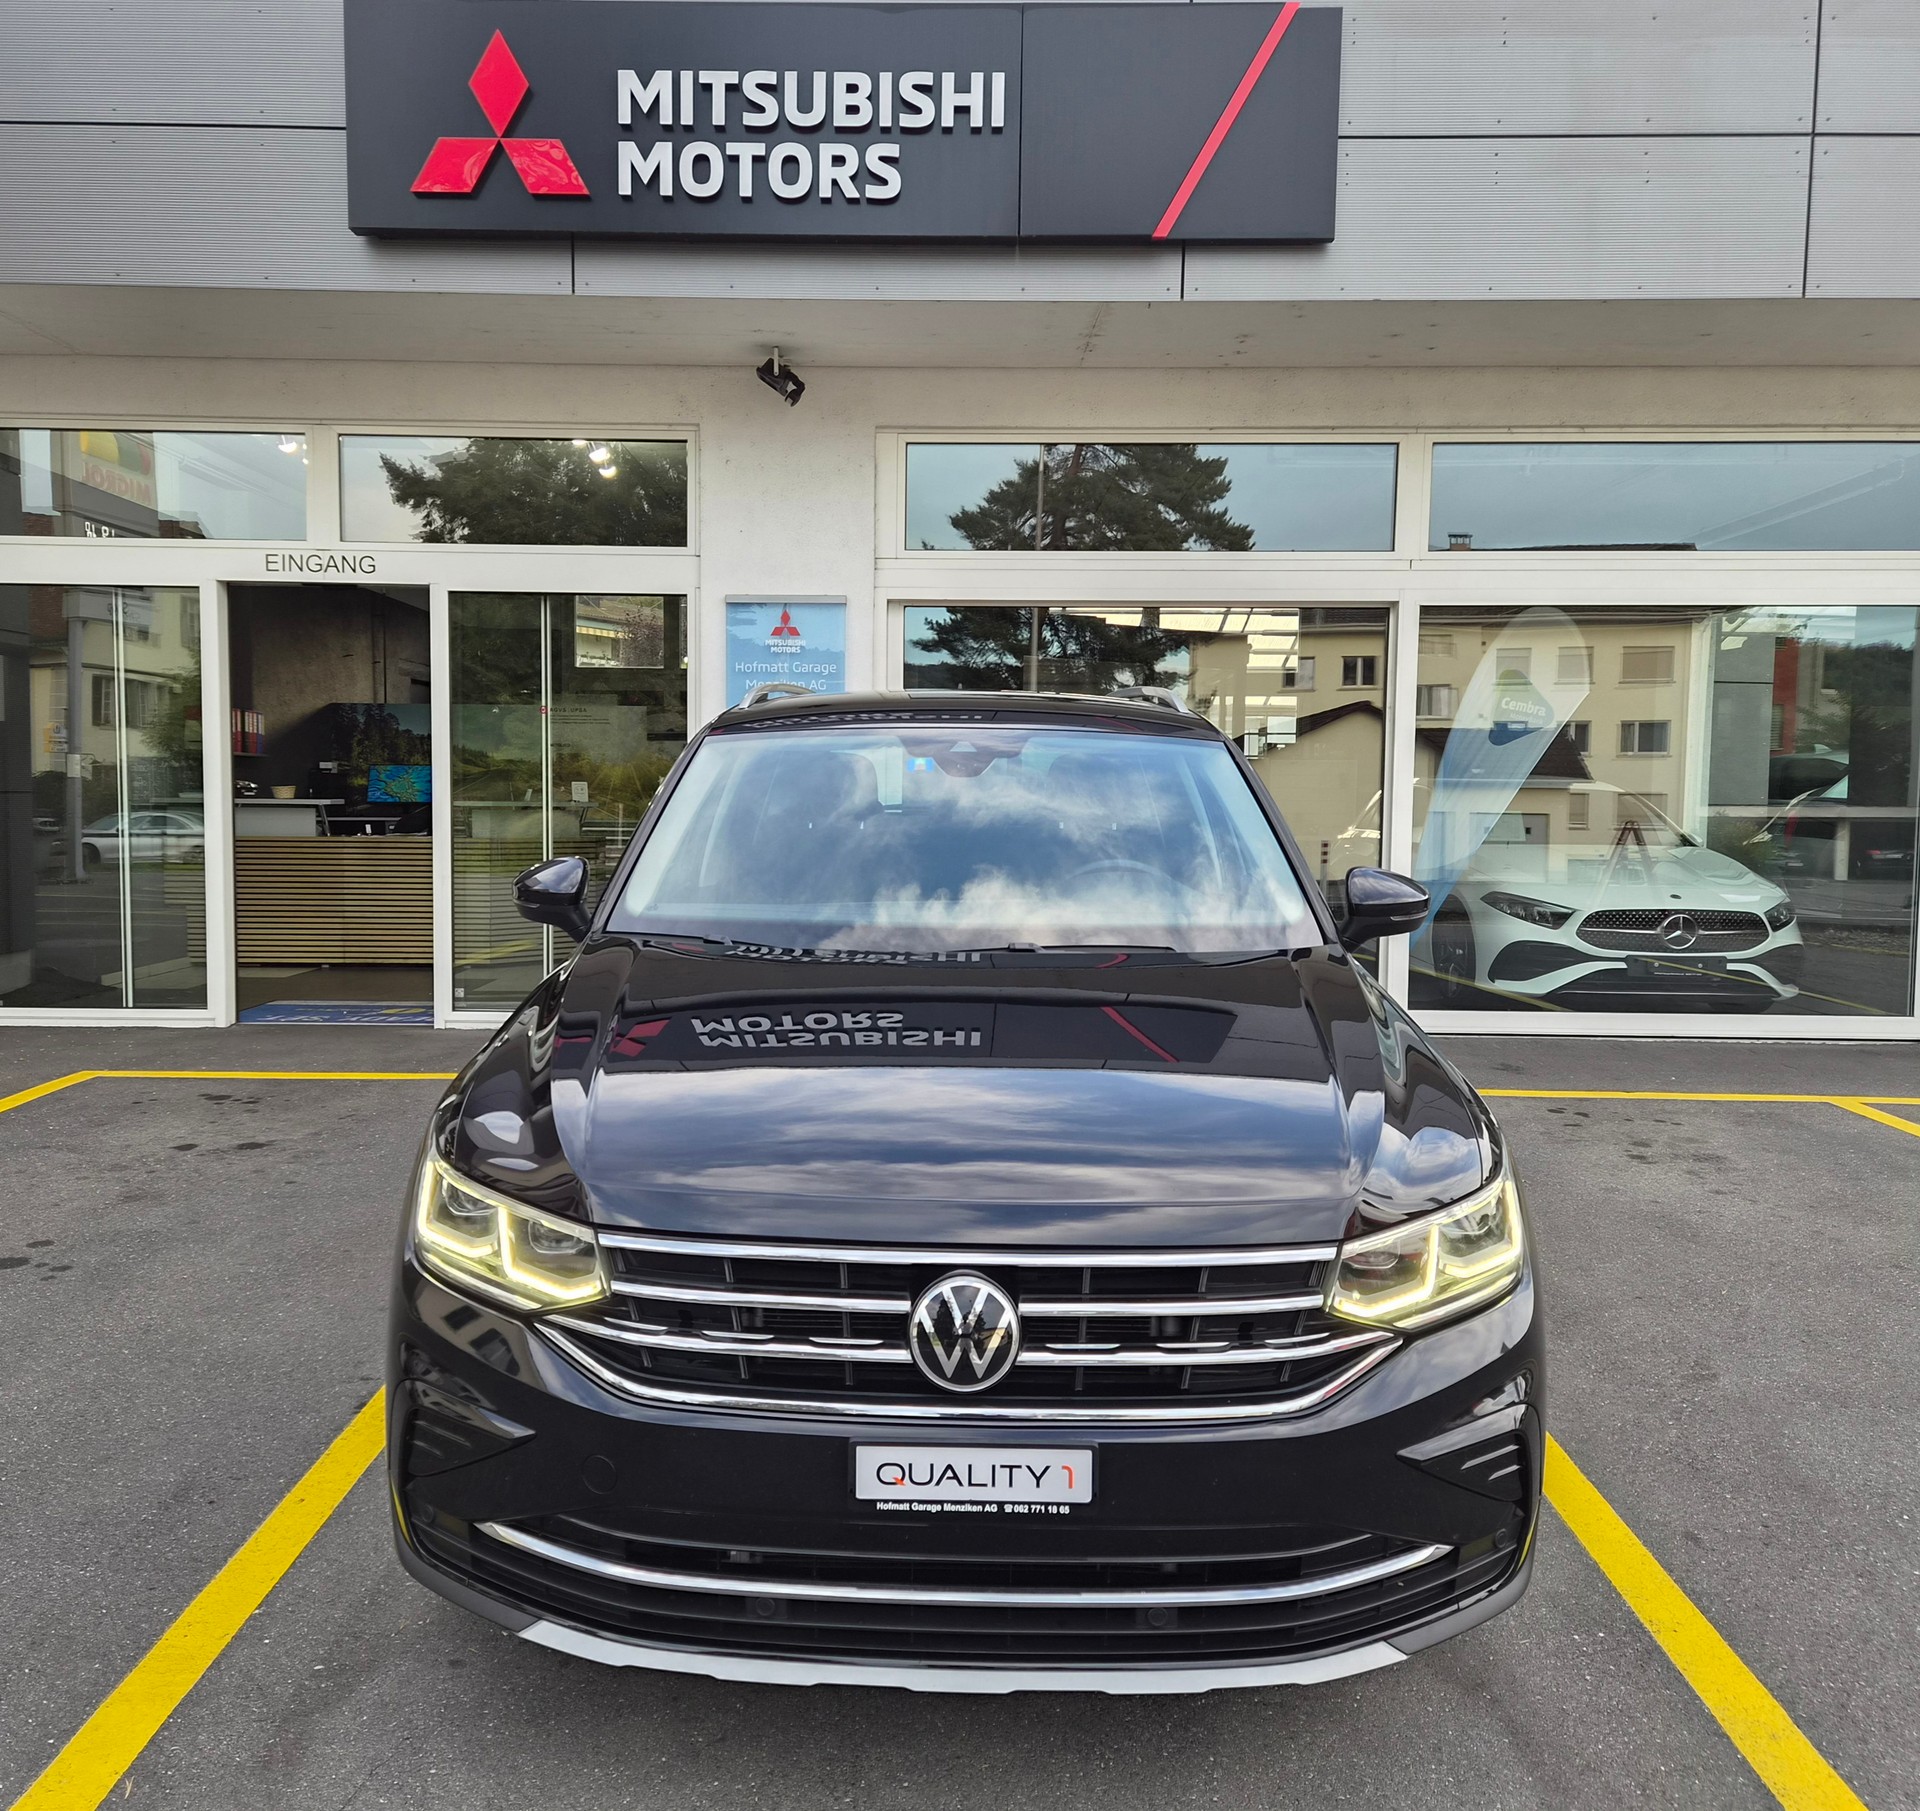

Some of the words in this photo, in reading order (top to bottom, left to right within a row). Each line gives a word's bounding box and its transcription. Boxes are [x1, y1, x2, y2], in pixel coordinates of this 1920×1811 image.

[617, 68, 1006, 131] MITSUBISHI
[617, 140, 903, 201] MOTORS
[265, 554, 376, 574] EINGANG
[765, 639, 806, 647] MITSUBISHI
[771, 646, 801, 654] MOTORS
[735, 661, 789, 673] Hofmatt
[792, 661, 837, 676] Garage
[809, 679, 826, 690] AG
[1501, 697, 1547, 717] Cembra
[912, 1278, 1017, 1388] VW
[876, 1462, 1051, 1489] QUALITY
[1061, 1464, 1075, 1490] 1
[876, 1501, 910, 1511] Hofmatt
[911, 1502, 942, 1513] Garage
[943, 1502, 983, 1512] Menziken
[984, 1503, 998, 1512] AG
[1013, 1504, 1029, 1514] 062
[1030, 1504, 1046, 1514] 771
[1047, 1504, 1058, 1514] 18
[1059, 1505, 1070, 1514] 65
